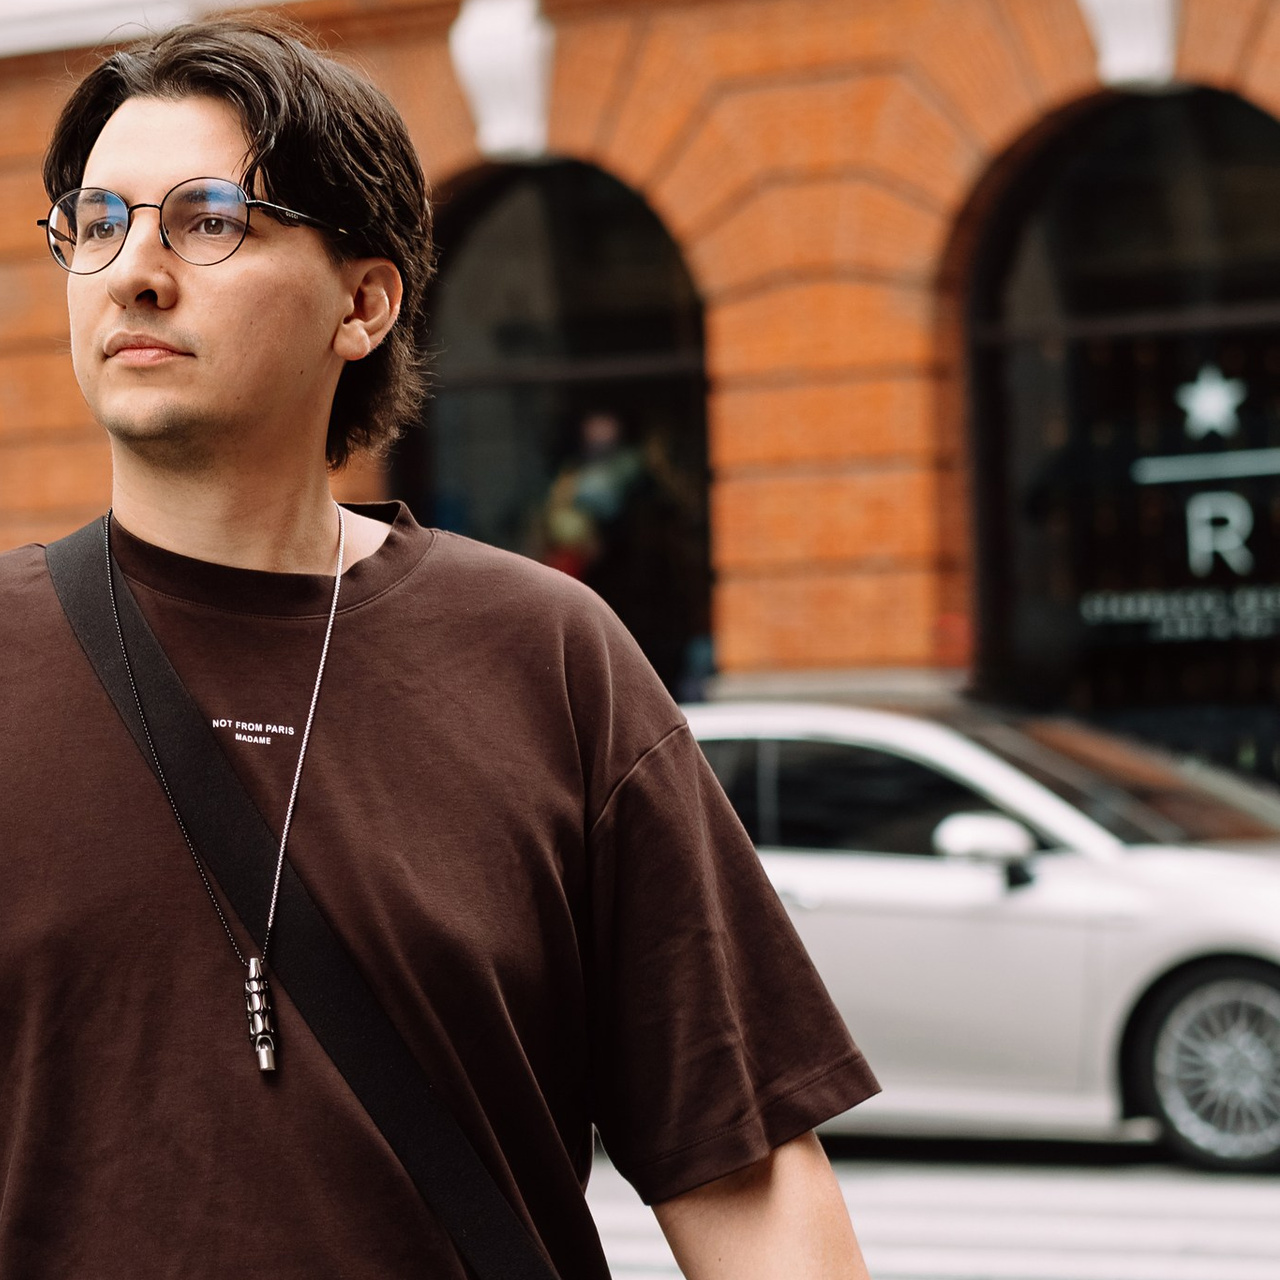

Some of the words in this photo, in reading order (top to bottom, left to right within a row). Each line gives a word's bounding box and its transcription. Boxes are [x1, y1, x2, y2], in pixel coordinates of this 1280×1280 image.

[1186, 490, 1255, 577] R
[212, 719, 233, 728] NOT
[235, 721, 263, 732] FROM
[265, 724, 295, 735] PARIS
[235, 733, 272, 745] MADAME
